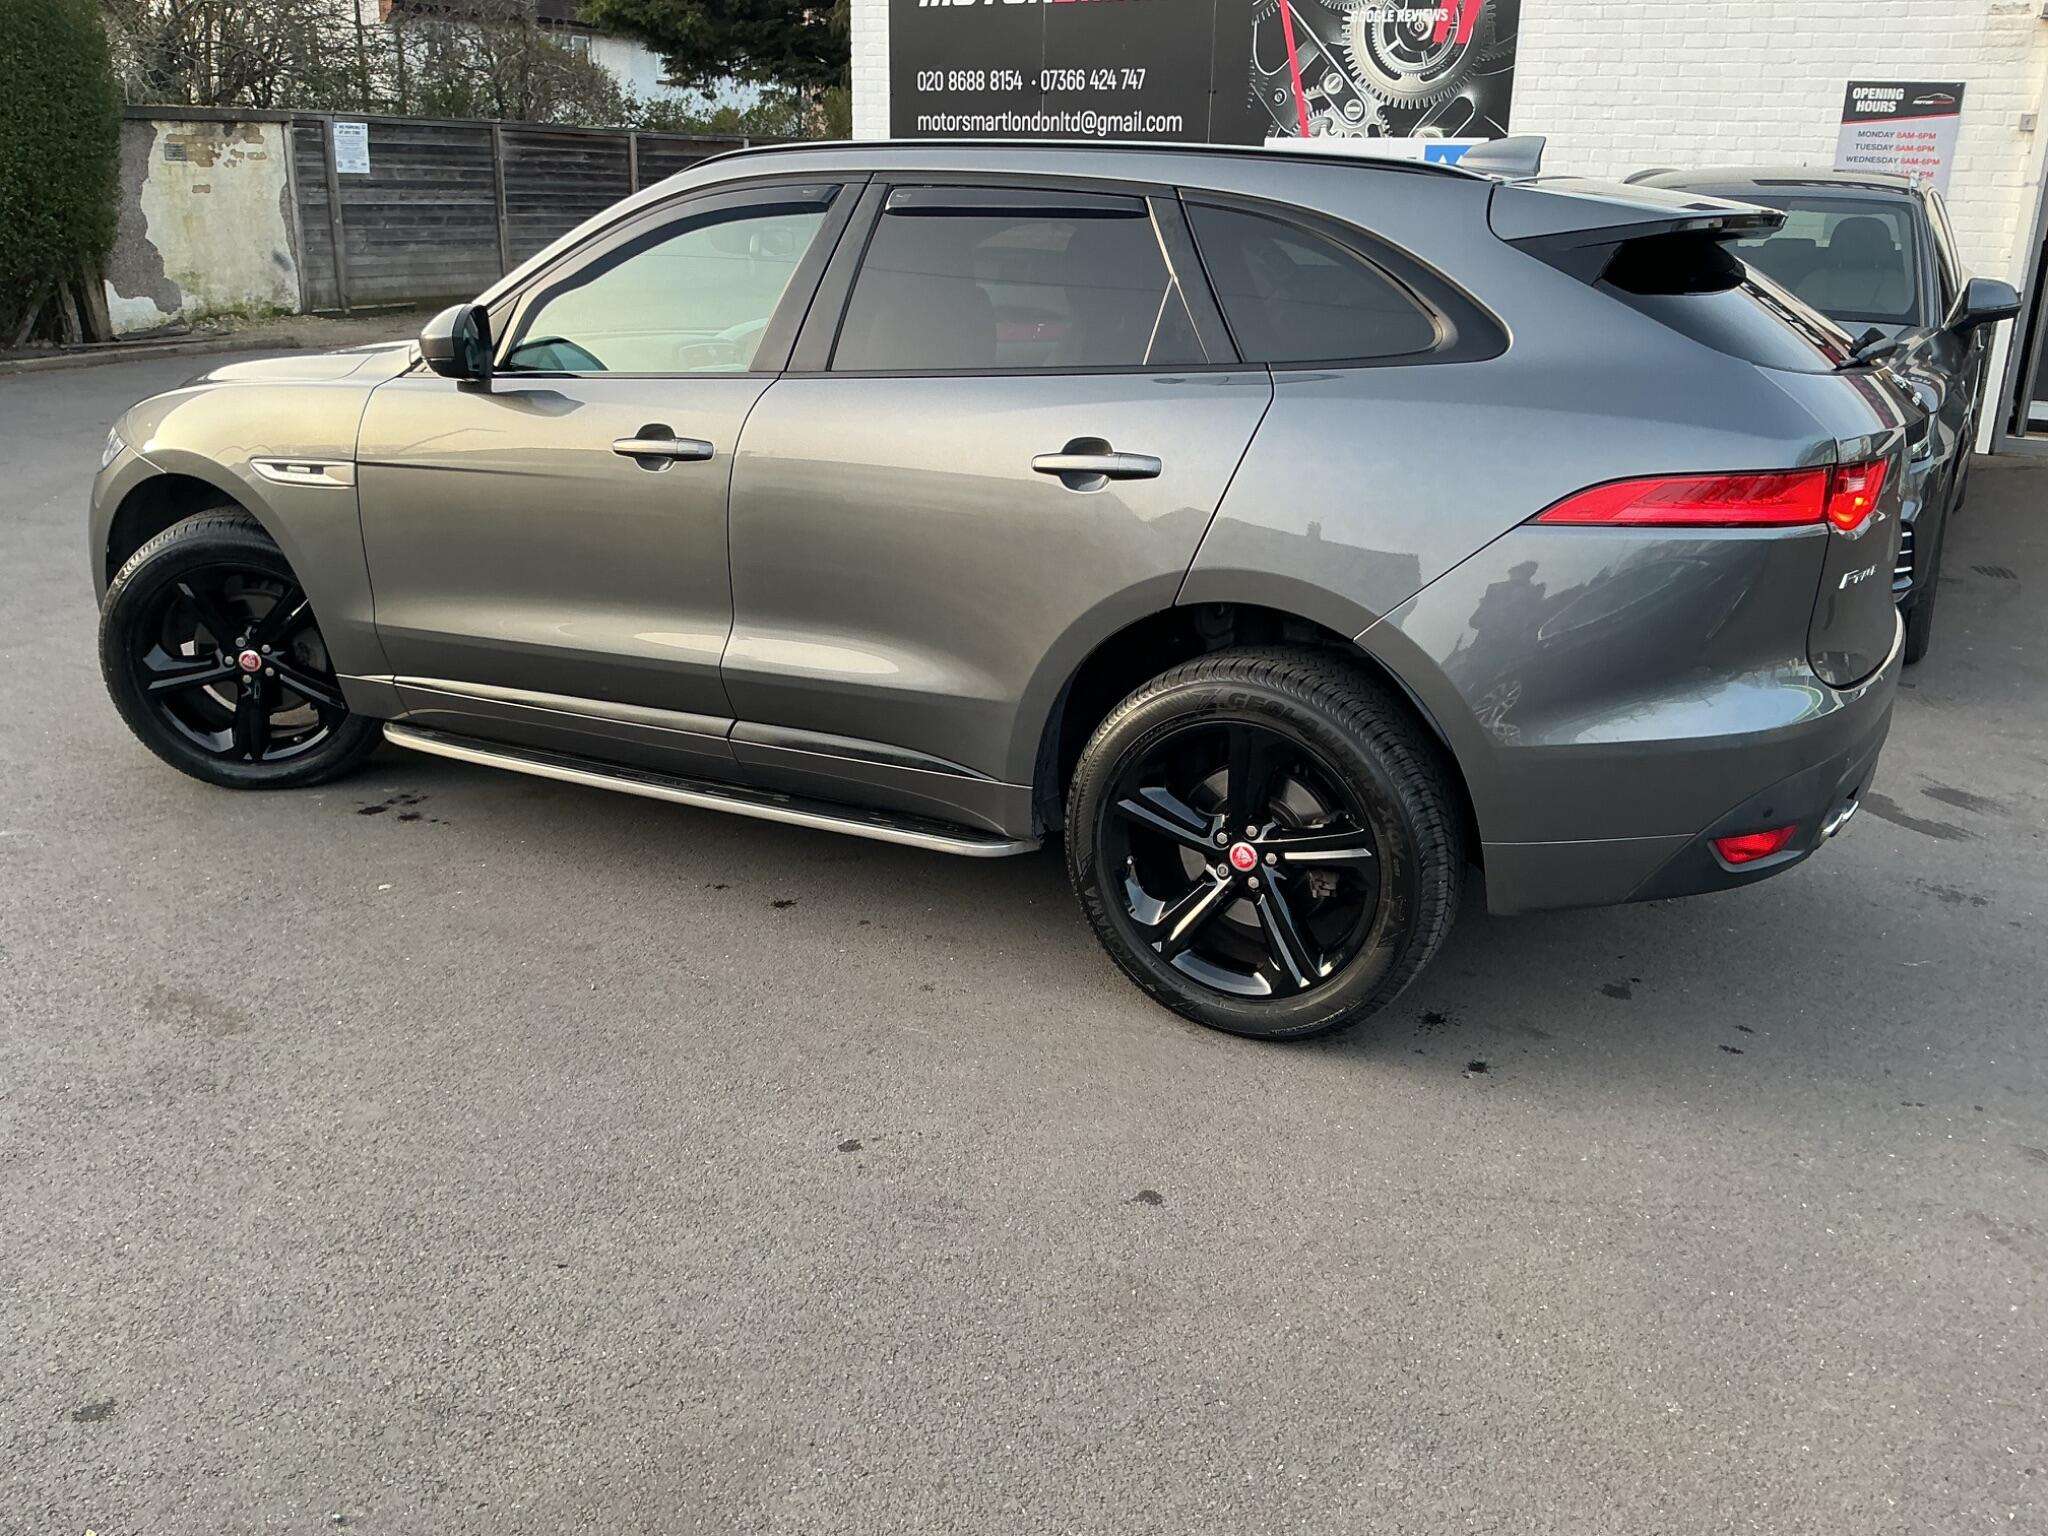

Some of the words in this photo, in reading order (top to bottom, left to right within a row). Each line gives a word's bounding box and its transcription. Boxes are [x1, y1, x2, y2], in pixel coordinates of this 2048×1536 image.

[1396, 8, 1449, 23] REVIEWS
[916, 70, 944, 92] 020
[948, 70, 985, 92] 8688
[989, 69, 1023, 91] 8154
[1040, 68, 1086, 91] 07366
[1089, 68, 1117, 90] 424
[1120, 68, 1146, 90] 747
[1852, 87, 1905, 100] OPENING
[1855, 100, 1898, 113] HOURS
[917, 109, 1183, 137] motorsmartlondonltd@gmail.com
[1857, 130, 1895, 138] MONDAY
[1855, 143, 1894, 151] TUESDAY
[1845, 155, 1898, 164] WEDNESDAY
